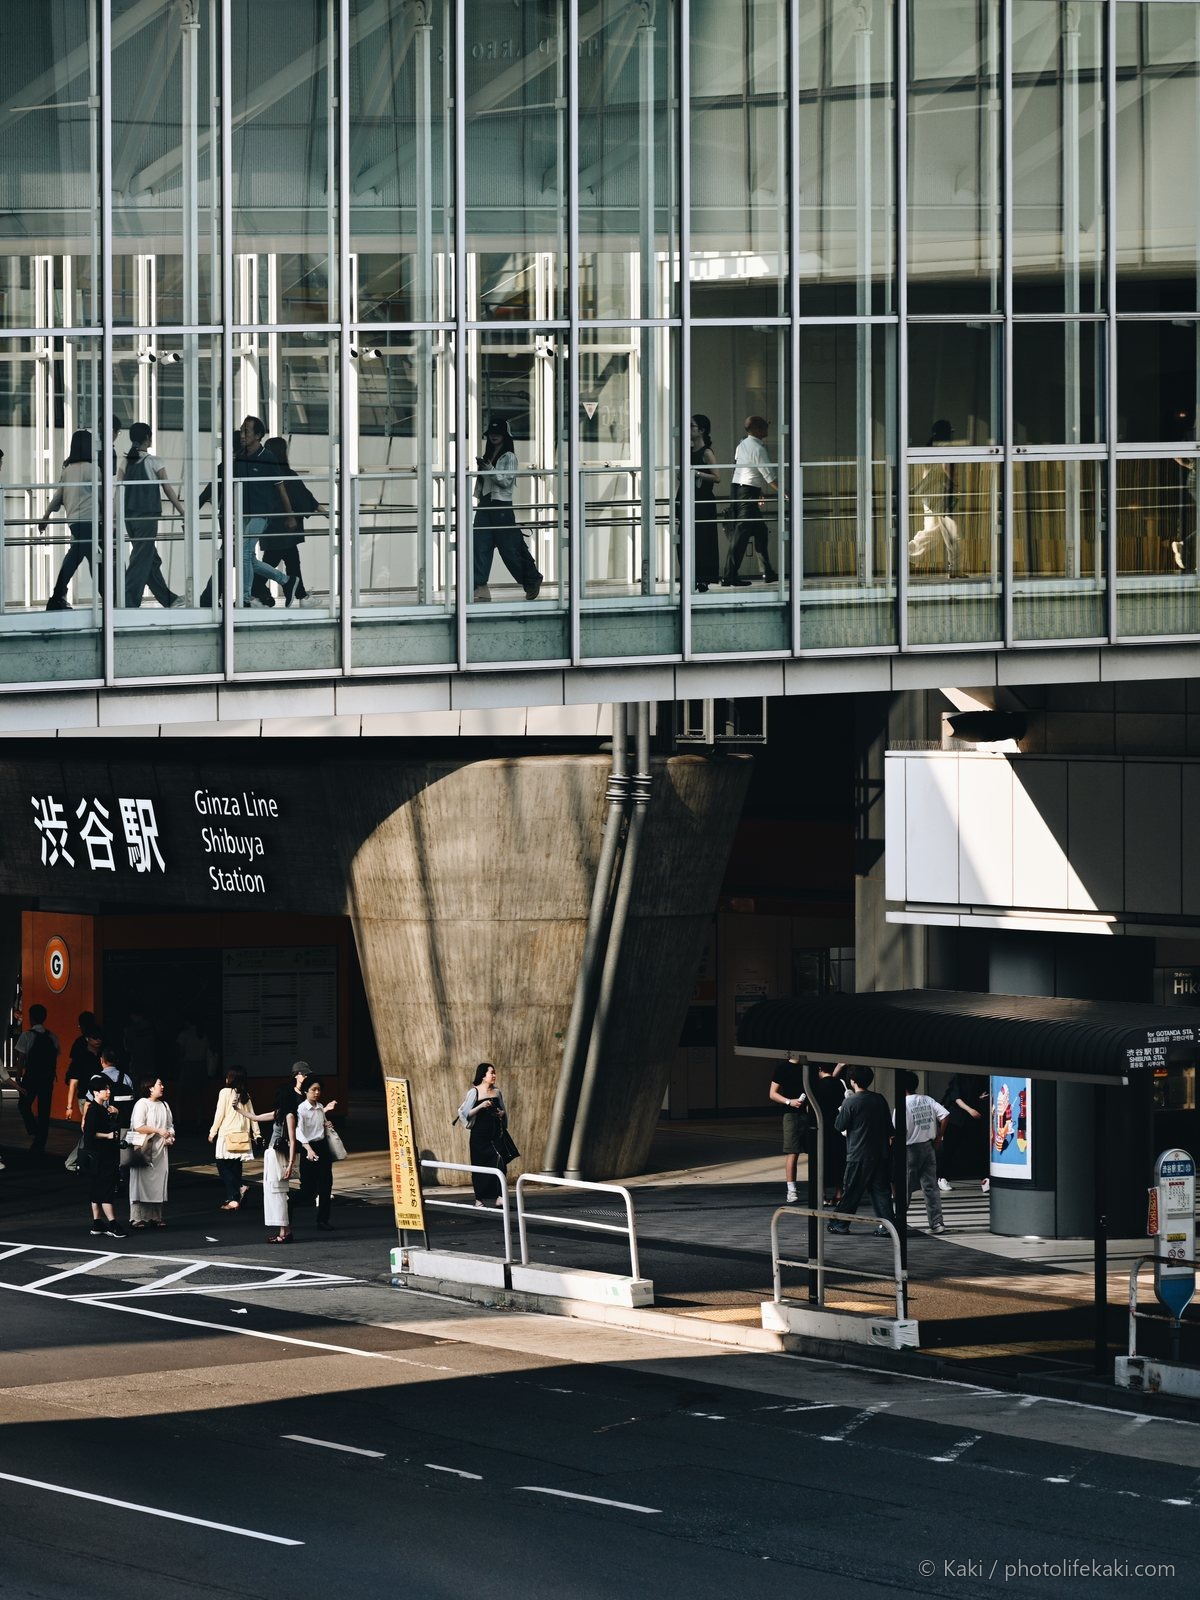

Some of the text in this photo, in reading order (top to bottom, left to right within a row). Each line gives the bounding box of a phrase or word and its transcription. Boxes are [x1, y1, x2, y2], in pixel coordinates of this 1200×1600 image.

[194, 790, 278, 818] Ginza Line
[31, 795, 165, 873] 渋谷駅
[202, 827, 265, 862] Shibuya
[209, 866, 265, 893] Station
[52, 954, 61, 975] G
[1174, 979, 1200, 994] Hik
